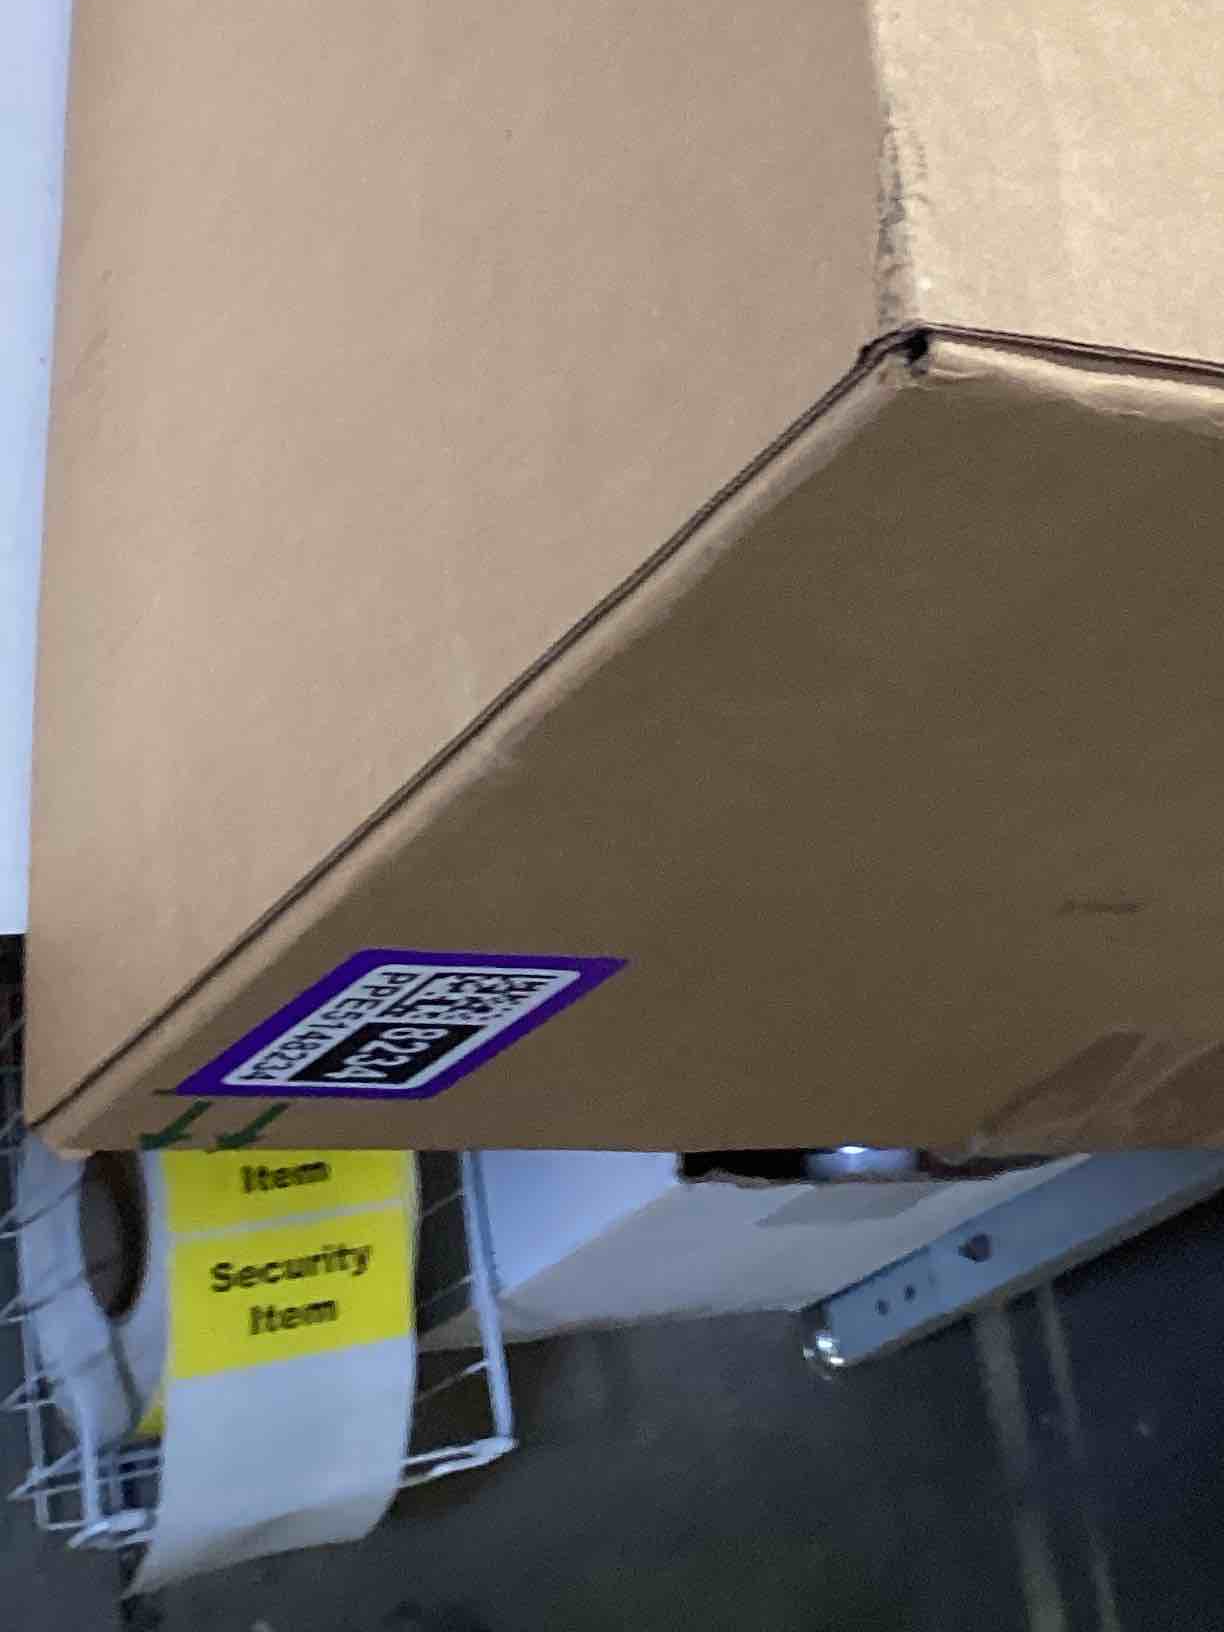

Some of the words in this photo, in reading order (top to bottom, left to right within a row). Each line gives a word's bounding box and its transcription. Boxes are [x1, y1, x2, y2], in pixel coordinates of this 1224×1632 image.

[238, 971, 419, 1080] PPE5148234
[323, 1027, 449, 1079] 8234
[241, 1161, 332, 1194] Item
[211, 1244, 372, 1292] Security
[249, 1300, 339, 1336] Item
